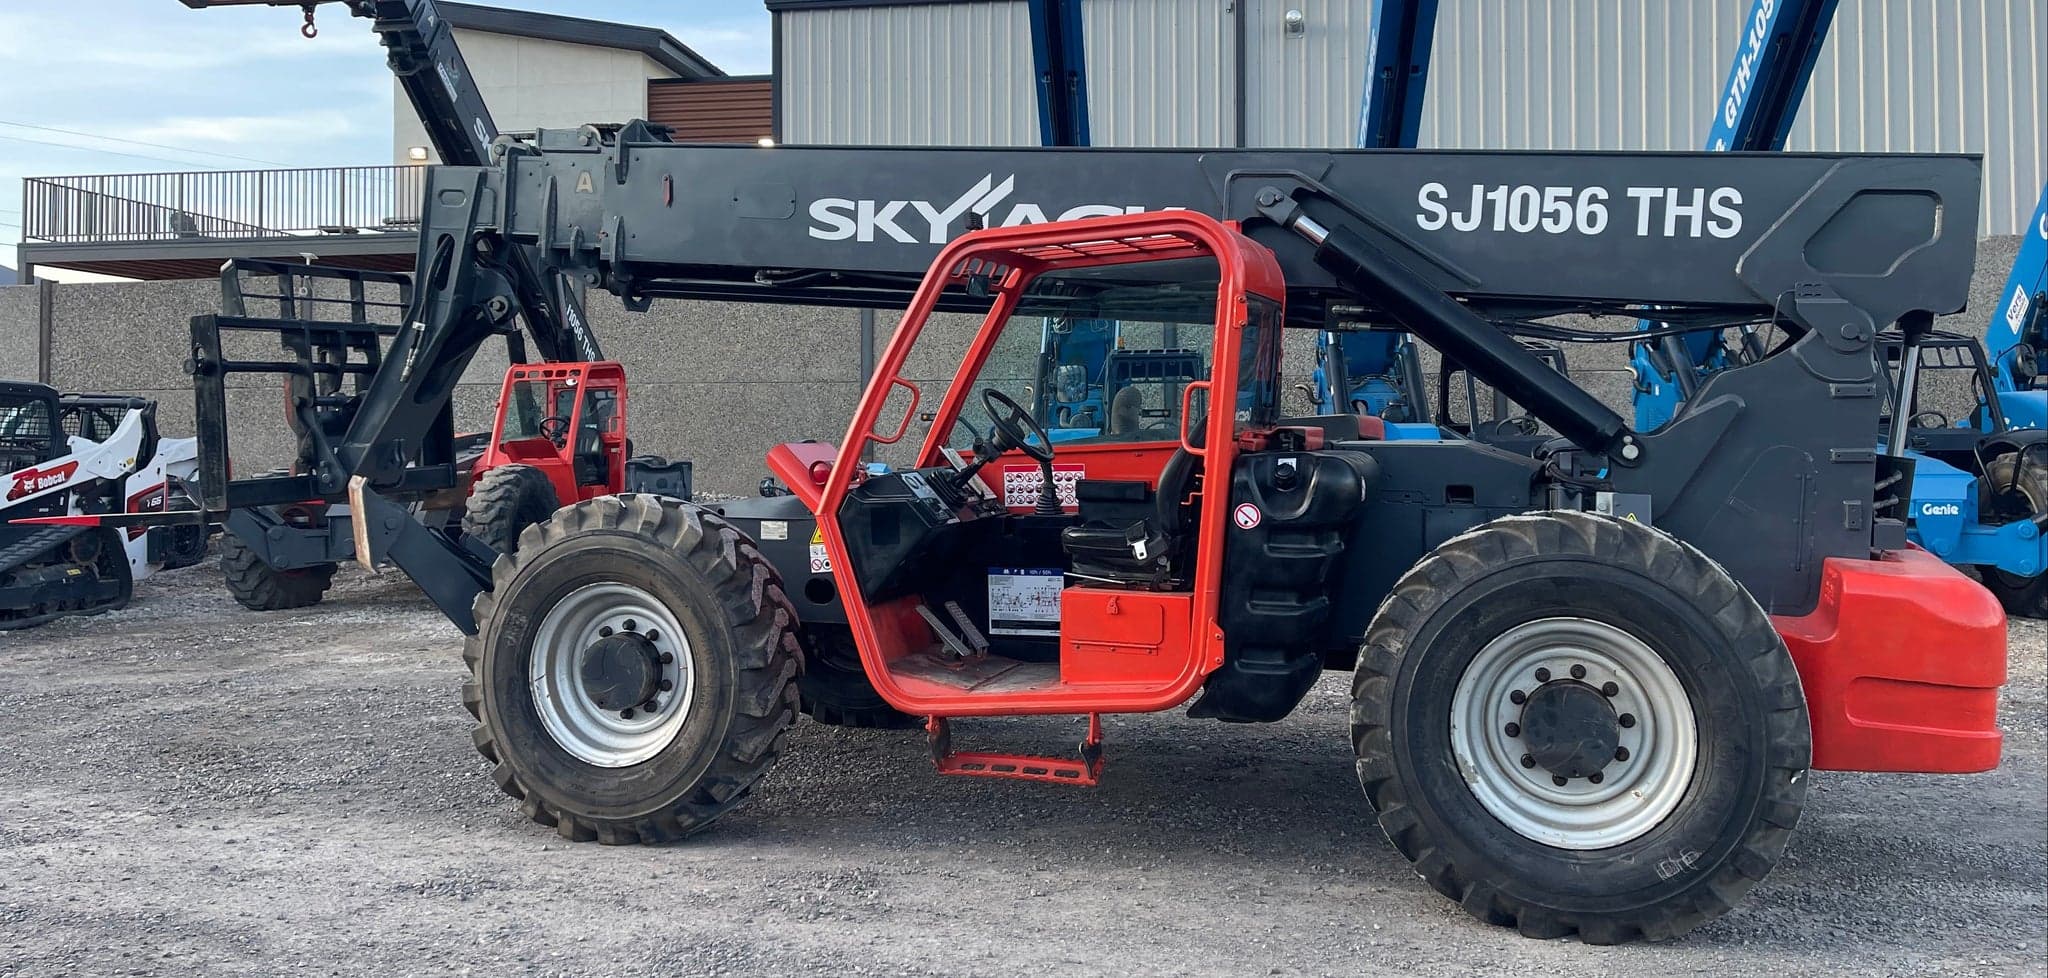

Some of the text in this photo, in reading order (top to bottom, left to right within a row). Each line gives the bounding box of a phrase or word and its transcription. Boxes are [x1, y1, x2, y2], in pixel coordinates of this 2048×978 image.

[576, 171, 594, 194] A
[1416, 182, 1743, 239] SJ1056 THS
[37, 470, 66, 490] Bobcat
[1922, 503, 1960, 516] Genie
